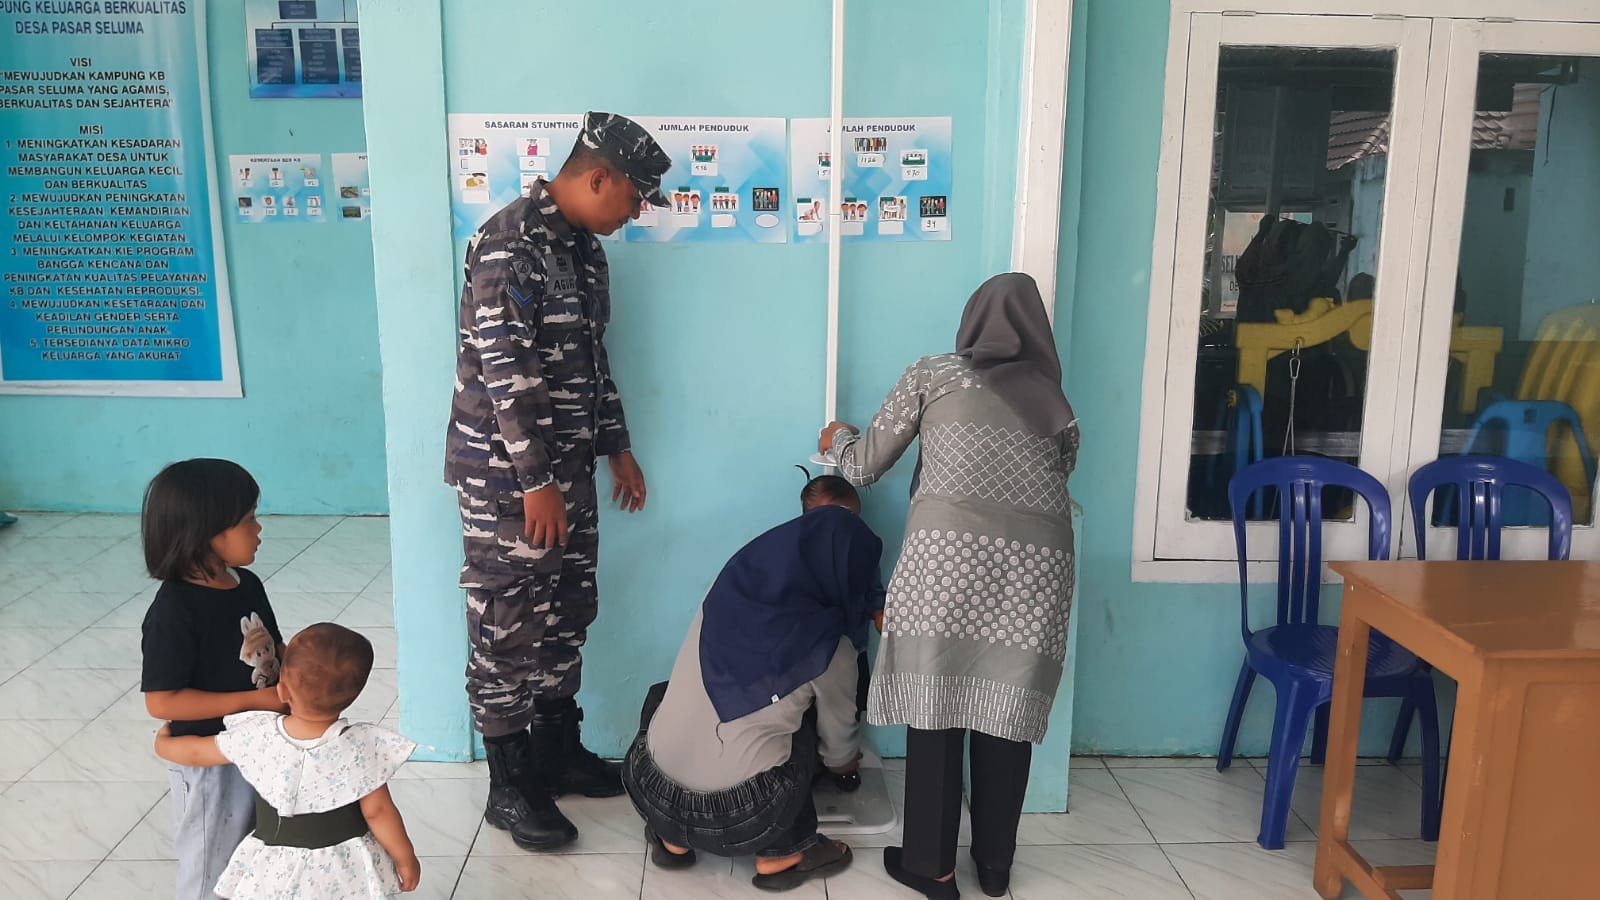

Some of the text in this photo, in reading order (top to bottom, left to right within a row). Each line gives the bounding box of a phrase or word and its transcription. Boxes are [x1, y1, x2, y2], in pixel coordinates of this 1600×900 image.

[36, 1, 100, 14] KELUARGA
[105, 1, 186, 14] BERKUALITAS
[16, 21, 144, 34] DESA PASAR SELUMA
[70, 58, 92, 67] VISI
[89, 72, 145, 81] KAMPUNG
[149, 72, 166, 81] KB
[0, 85, 170, 95] PASAR SELUMA YANG AGAMIS,
[0, 99, 72, 108] BERKUALITAS
[76, 99, 100, 108] DAN
[484, 121, 579, 129] SASARAN STUNTING
[658, 124, 749, 132] JUMLAH PENDUDUK
[866, 124, 916, 132] PENDUDUK
[80, 125, 104, 135] MISI
[18, 140, 108, 148] MENINGKATKAN
[111, 140, 180, 148] KESADARAN
[19, 153, 168, 162] MASYARAKAT DESA UNTUK
[8, 167, 182, 176] MEMBANGUN KELUARGA KECIL
[45, 180, 147, 189] DAN BERKUALITAS
[22, 194, 102, 202] MEWUJUDKAN
[106, 194, 186, 202] PENINGKATAN
[110, 207, 190, 216] KEMANDIRIAN
[18, 221, 182, 229] DAN KELTAHANAN KELUARGA
[14, 234, 60, 243] MELALUI
[64, 234, 126, 243] KELOMPOK
[23, 247, 112, 256] MENINGKATKAN
[116, 247, 133, 256] KIE
[137, 247, 194, 256] PROGRAM
[38, 260, 168, 269] BANGGA KENCANA DAN
[4, 273, 207, 282] PENINGKATAN KUALITAS PELAYANAN
[10, 287, 24, 295] KB
[28, 287, 51, 295] DAN
[58, 287, 122, 295] KESEHATAN
[22, 300, 100, 309] MEWUJUDKAN
[104, 300, 177, 309] KESETARAAN
[182, 300, 204, 309] DAN
[36, 313, 179, 322] KEADILAN GENDER SERTA
[47, 326, 134, 335] PERLINDUNGAN
[44, 339, 118, 348] TERSEDIANYA
[122, 339, 150, 348] DATA
[154, 339, 190, 348] MIKRO
[42, 352, 181, 360] KELUARGA YANG AKURAT
